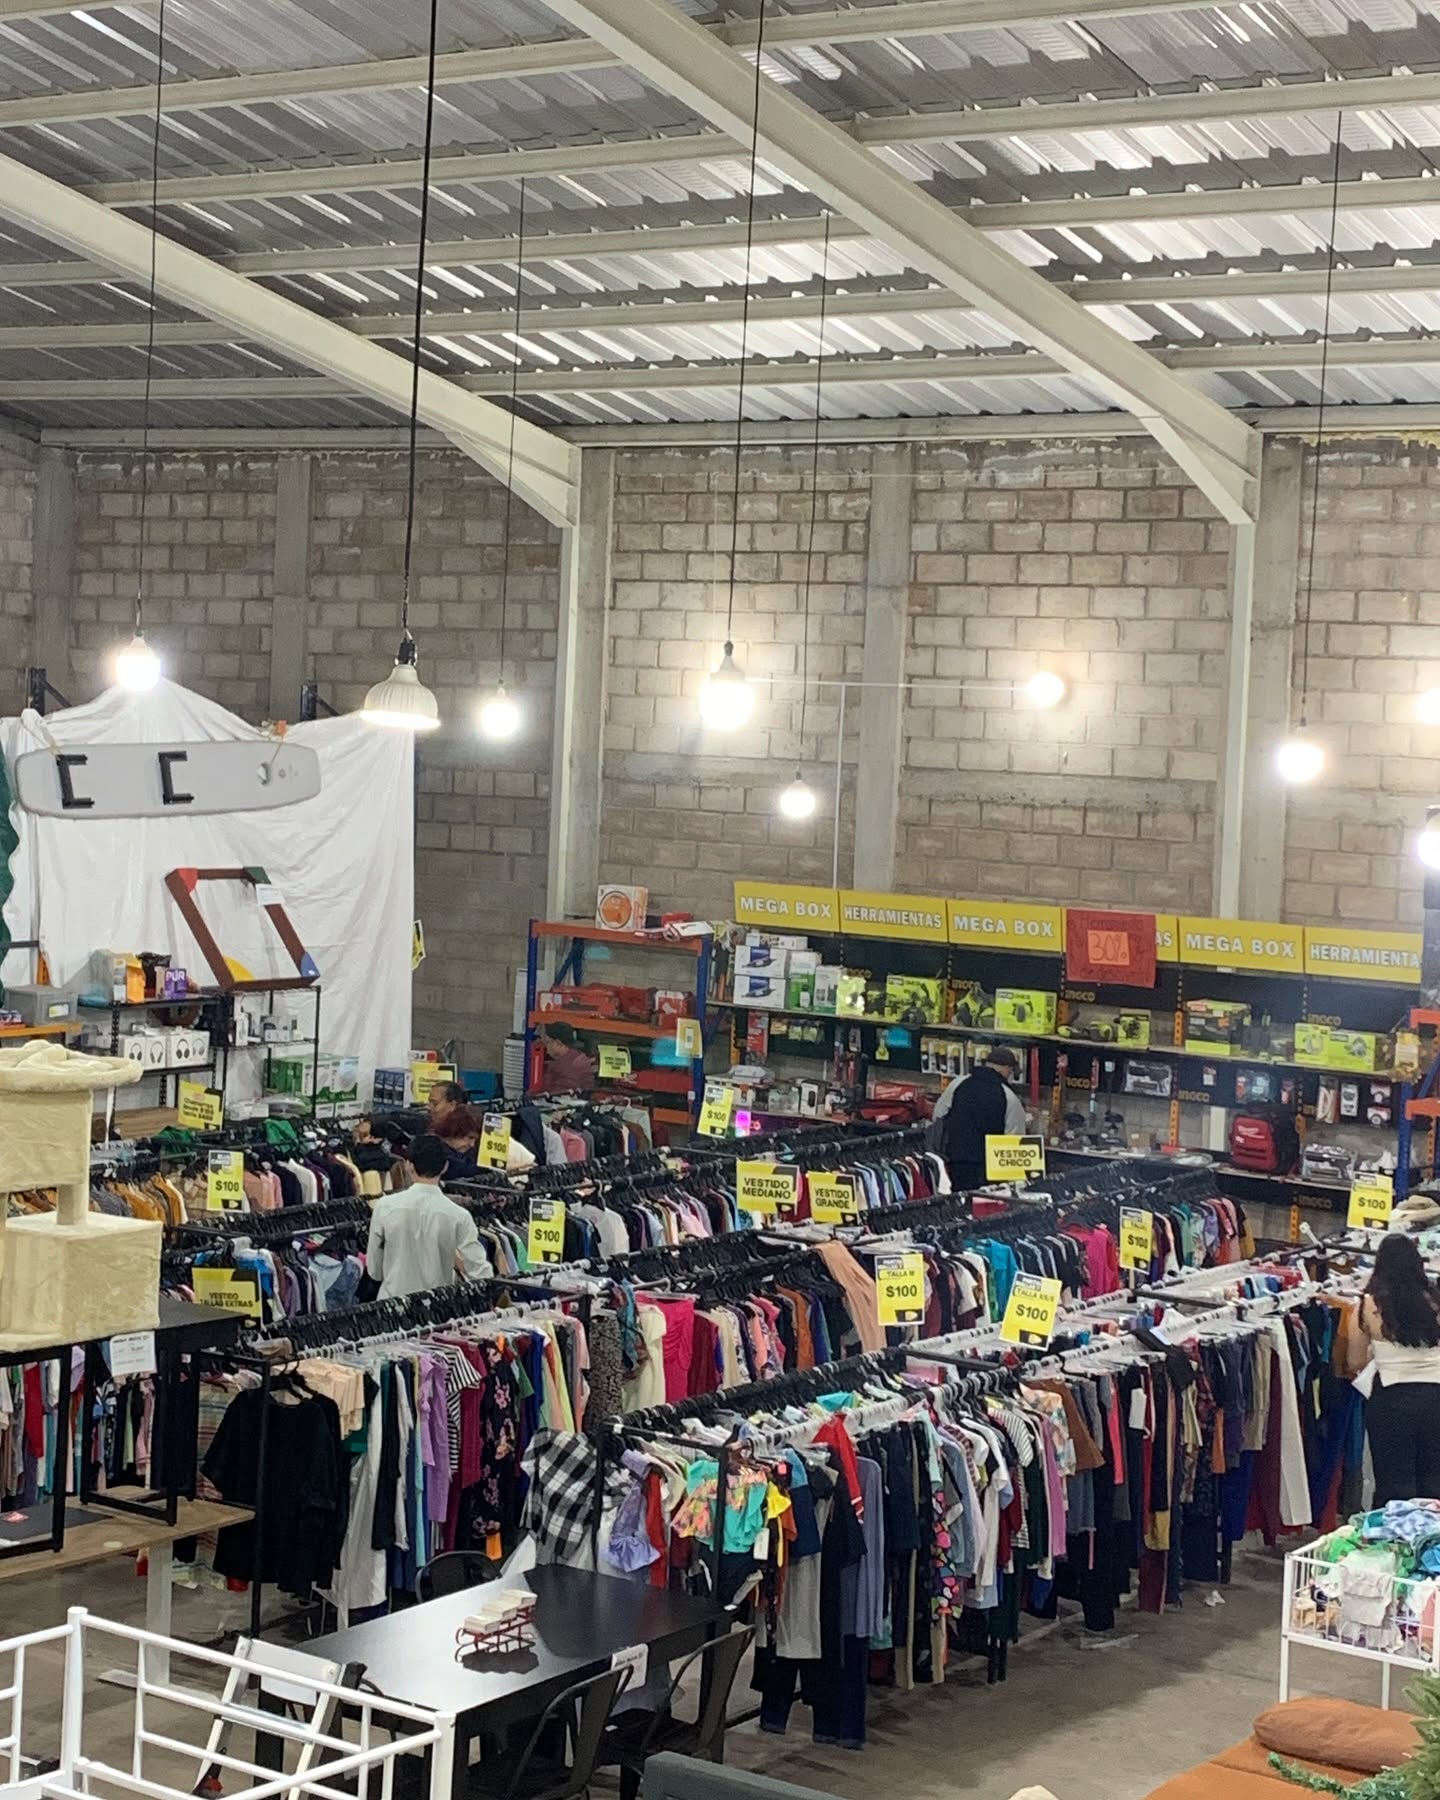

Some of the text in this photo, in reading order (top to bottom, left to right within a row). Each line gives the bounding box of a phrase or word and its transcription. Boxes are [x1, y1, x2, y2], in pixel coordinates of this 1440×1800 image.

[740, 896, 832, 919] MEGA BOX
[844, 906, 943, 929] HERRAMIENTAS
[954, 915, 1007, 935] MEGA
[1013, 920, 1055, 938] BOX
[1186, 933, 1245, 954] MEGA
[1252, 939, 1296, 958] BOX
[1310, 944, 1421, 969] HERRAMIENTA
[707, 1110, 727, 1121] $100
[486, 1140, 507, 1154] $100
[993, 1150, 1037, 1159] VESTIDO
[998, 1159, 1032, 1167] CHICO
[215, 1180, 240, 1192] $100
[744, 1178, 790, 1190] VESTIDO
[742, 1187, 791, 1200] MEDIANO
[814, 1187, 850, 1199] VESTIDO
[815, 1199, 850, 1209] GRANDE
[1358, 1197, 1386, 1210] $100
[534, 1228, 560, 1242] $100
[885, 1284, 918, 1298] $100
[1016, 1304, 1049, 1322] $100
